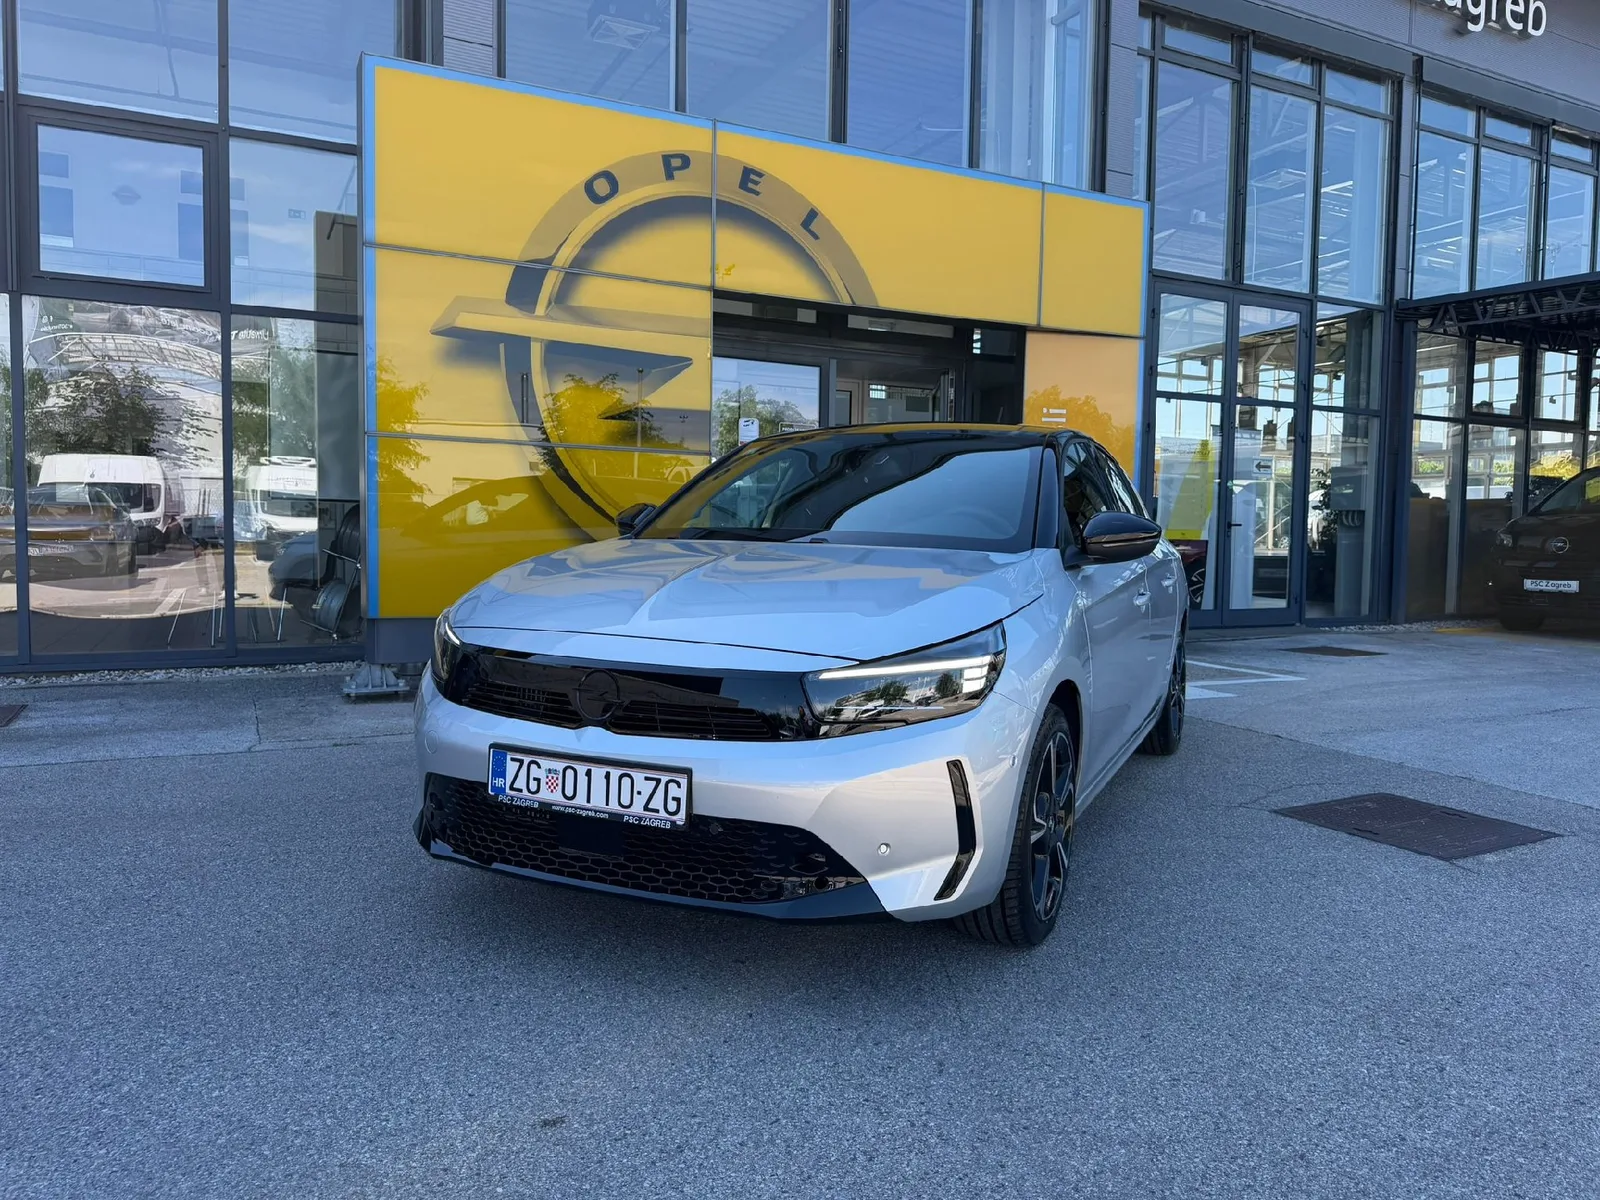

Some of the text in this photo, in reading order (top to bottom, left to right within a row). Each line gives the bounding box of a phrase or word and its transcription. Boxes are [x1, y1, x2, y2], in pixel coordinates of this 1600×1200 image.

[1436, 0, 1547, 37] greb
[583, 152, 822, 242] OPEL
[1530, 580, 1572, 589] PSC Zagreb
[492, 777, 506, 788] HR
[508, 757, 542, 795] ZG
[498, 794, 539, 808] PSC ZAGREB
[551, 805, 609, 819] www.psc-zagreb.com
[623, 815, 671, 829] PSC ZAGREB
